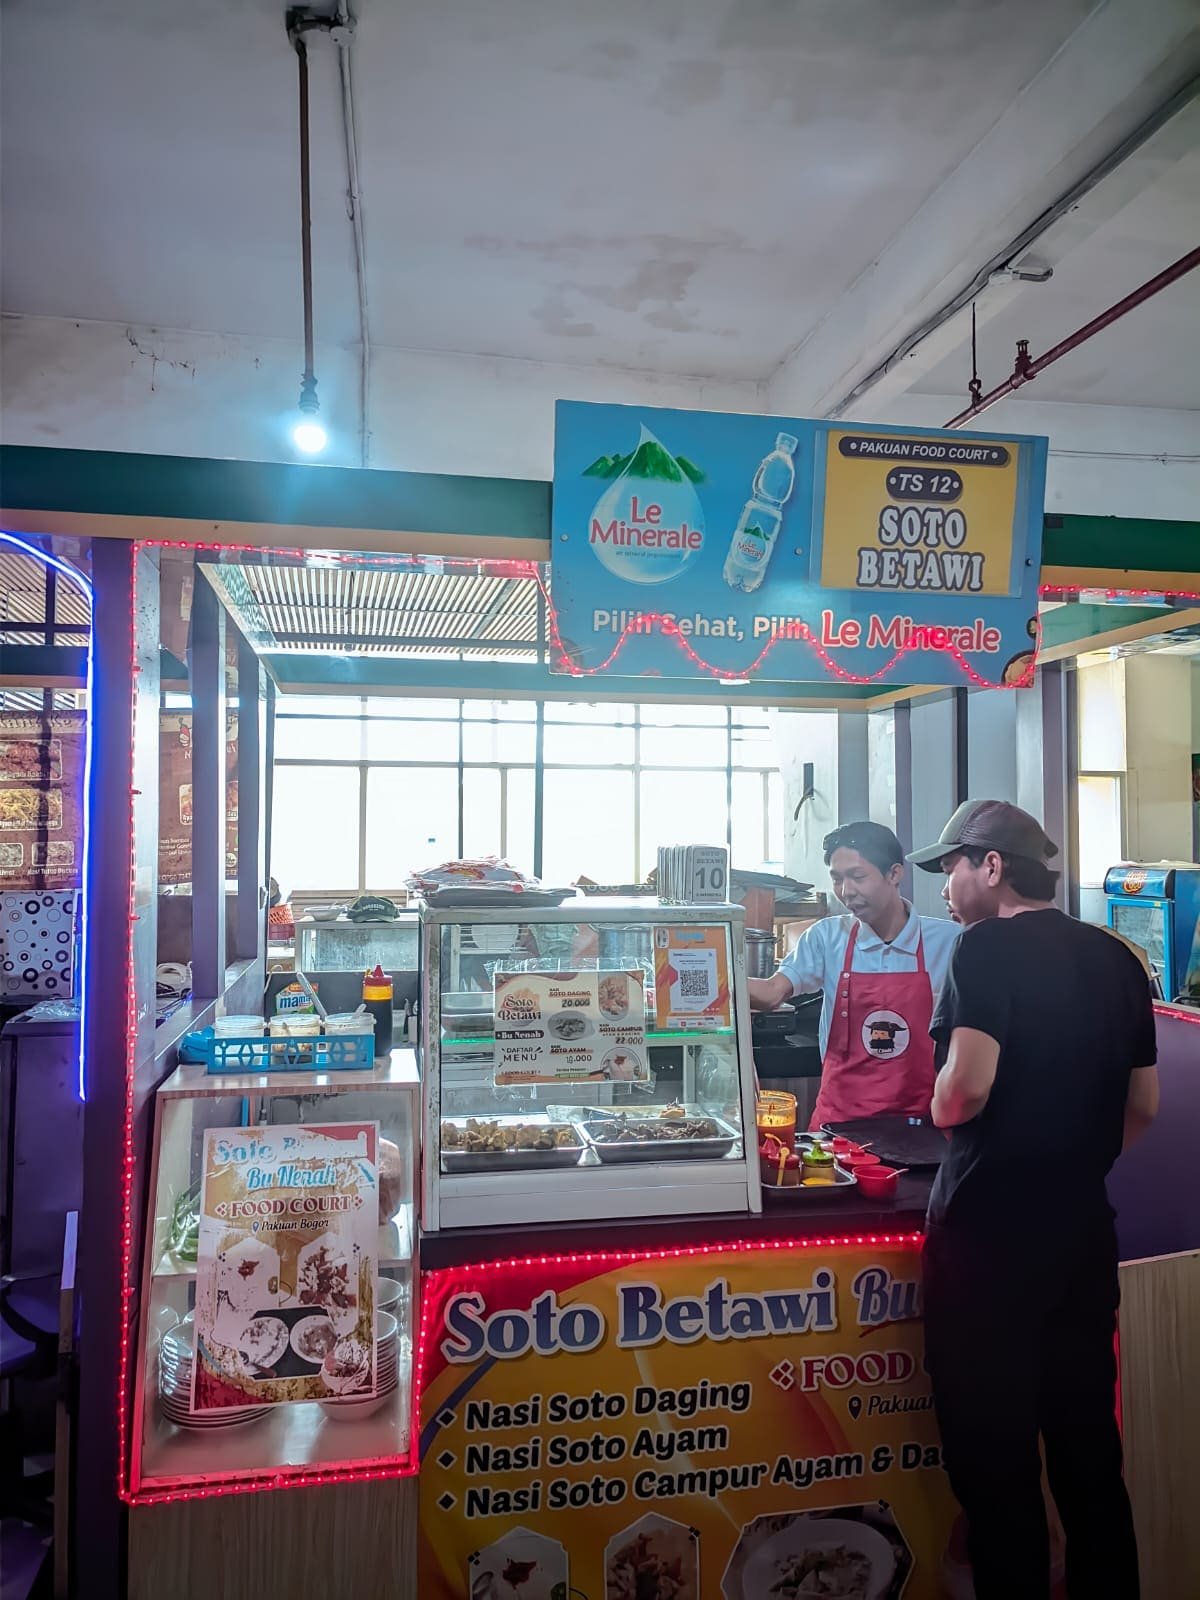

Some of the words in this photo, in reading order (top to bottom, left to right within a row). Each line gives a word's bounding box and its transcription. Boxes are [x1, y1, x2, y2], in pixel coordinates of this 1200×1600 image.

[859, 441, 909, 456] PAKUAN
[912, 444, 946, 459] FOOD
[949, 447, 990, 461] COURT
[900, 473, 924, 492] TS
[929, 476, 952, 493] 12
[631, 495, 662, 525] Le
[589, 518, 703, 550] Minerale
[879, 505, 967, 548] SOTO
[857, 547, 985, 591] BETAWI
[593, 609, 652, 634] Pilih
[661, 611, 744, 641] Sehat,
[753, 616, 809, 640] Pilih
[821, 609, 861, 648] Le
[867, 614, 1001, 654] Minerale
[695, 867, 723, 889] 10
[497, 1009, 542, 1021] Betawi
[503, 994, 536, 1008] Soto
[503, 1053, 538, 1062] MENU
[247, 1166, 274, 1189] Bu
[231, 1199, 285, 1218] FOOD
[289, 1194, 353, 1214] COURT
[261, 1220, 298, 1231] Pakuan
[300, 1219, 329, 1232] Bogor
[440, 1290, 605, 1364] Soto
[615, 1267, 838, 1348] Betawi
[852, 1265, 920, 1326] Bu
[800, 1350, 915, 1392] FOOD
[463, 1400, 541, 1432] Nasi
[549, 1389, 628, 1420] Soto
[633, 1380, 752, 1416] Daging
[463, 1441, 541, 1475] Nasi
[548, 1433, 628, 1466] Soto
[632, 1425, 728, 1459] Ayam
[463, 1485, 541, 1519] Nasi
[548, 1476, 628, 1509] Soto
[633, 1464, 769, 1502] Campur
[771, 1452, 863, 1488] Ayam
[871, 1443, 895, 1474] &
